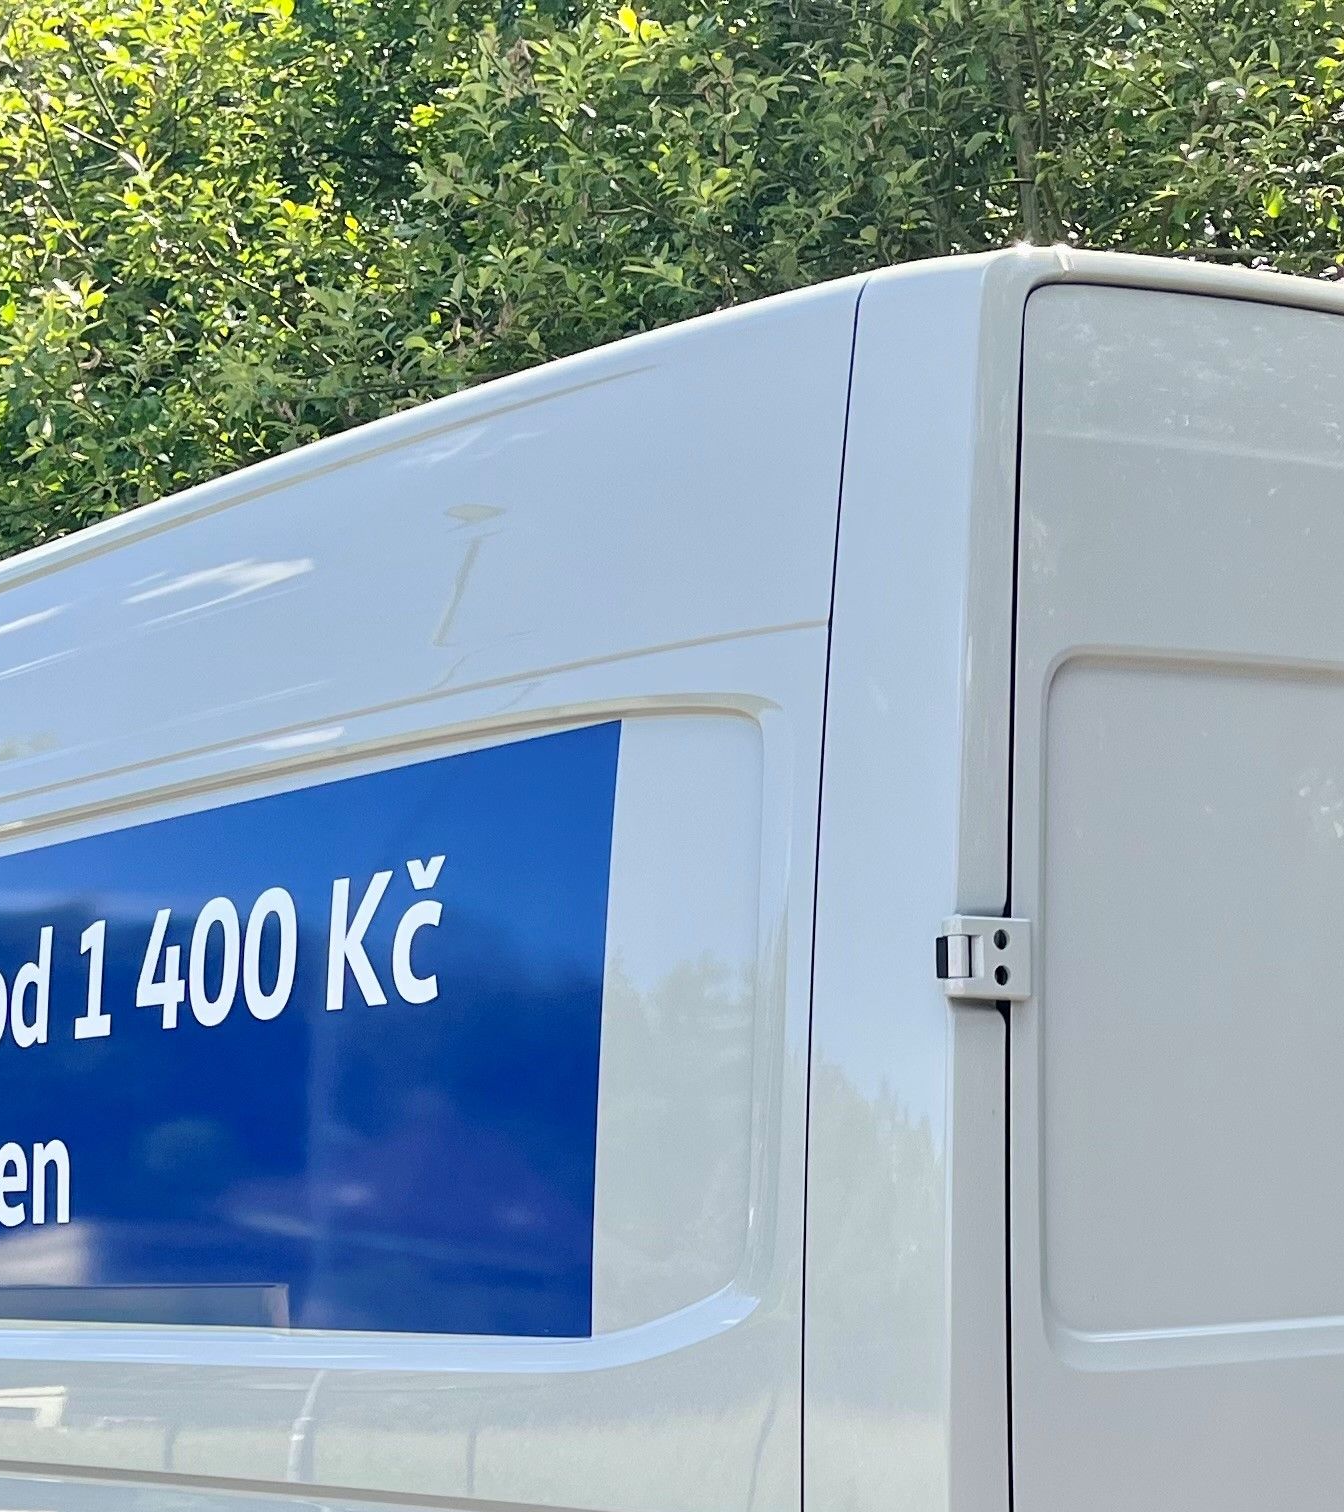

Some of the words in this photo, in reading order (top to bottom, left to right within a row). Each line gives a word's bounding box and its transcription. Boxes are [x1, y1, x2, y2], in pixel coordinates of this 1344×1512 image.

[74, 920, 112, 1040] 1
[136, 886, 297, 1030] 400
[325, 854, 447, 1011] Kč
